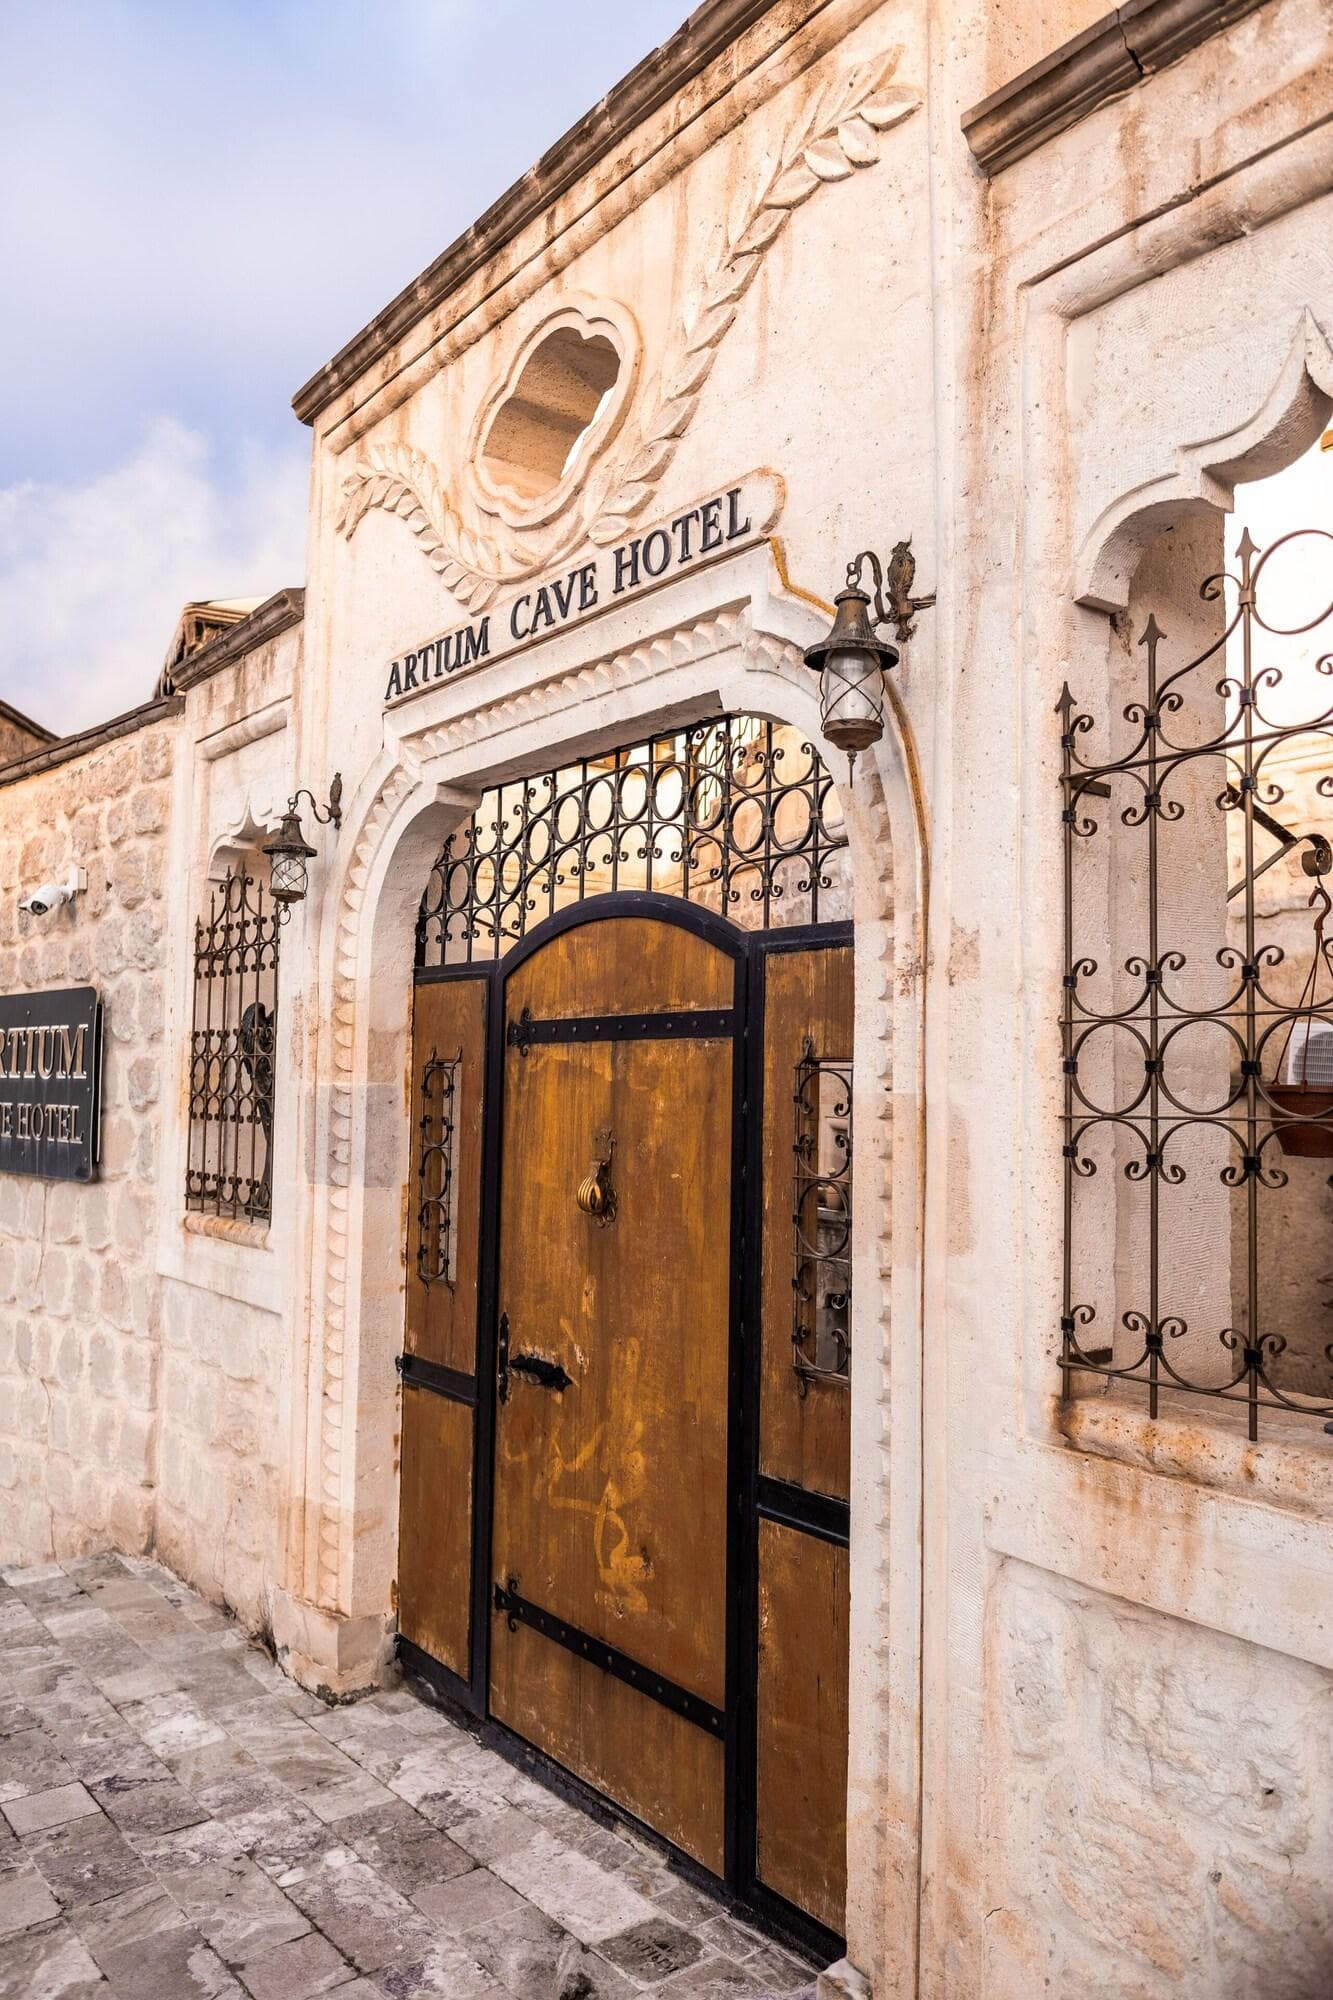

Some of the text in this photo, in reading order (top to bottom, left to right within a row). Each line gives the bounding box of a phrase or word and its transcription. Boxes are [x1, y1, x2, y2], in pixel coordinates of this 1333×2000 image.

[384, 487, 752, 700] ARTIUM CAVE HOTEL
[16, 1103, 84, 1144] HOTEL
